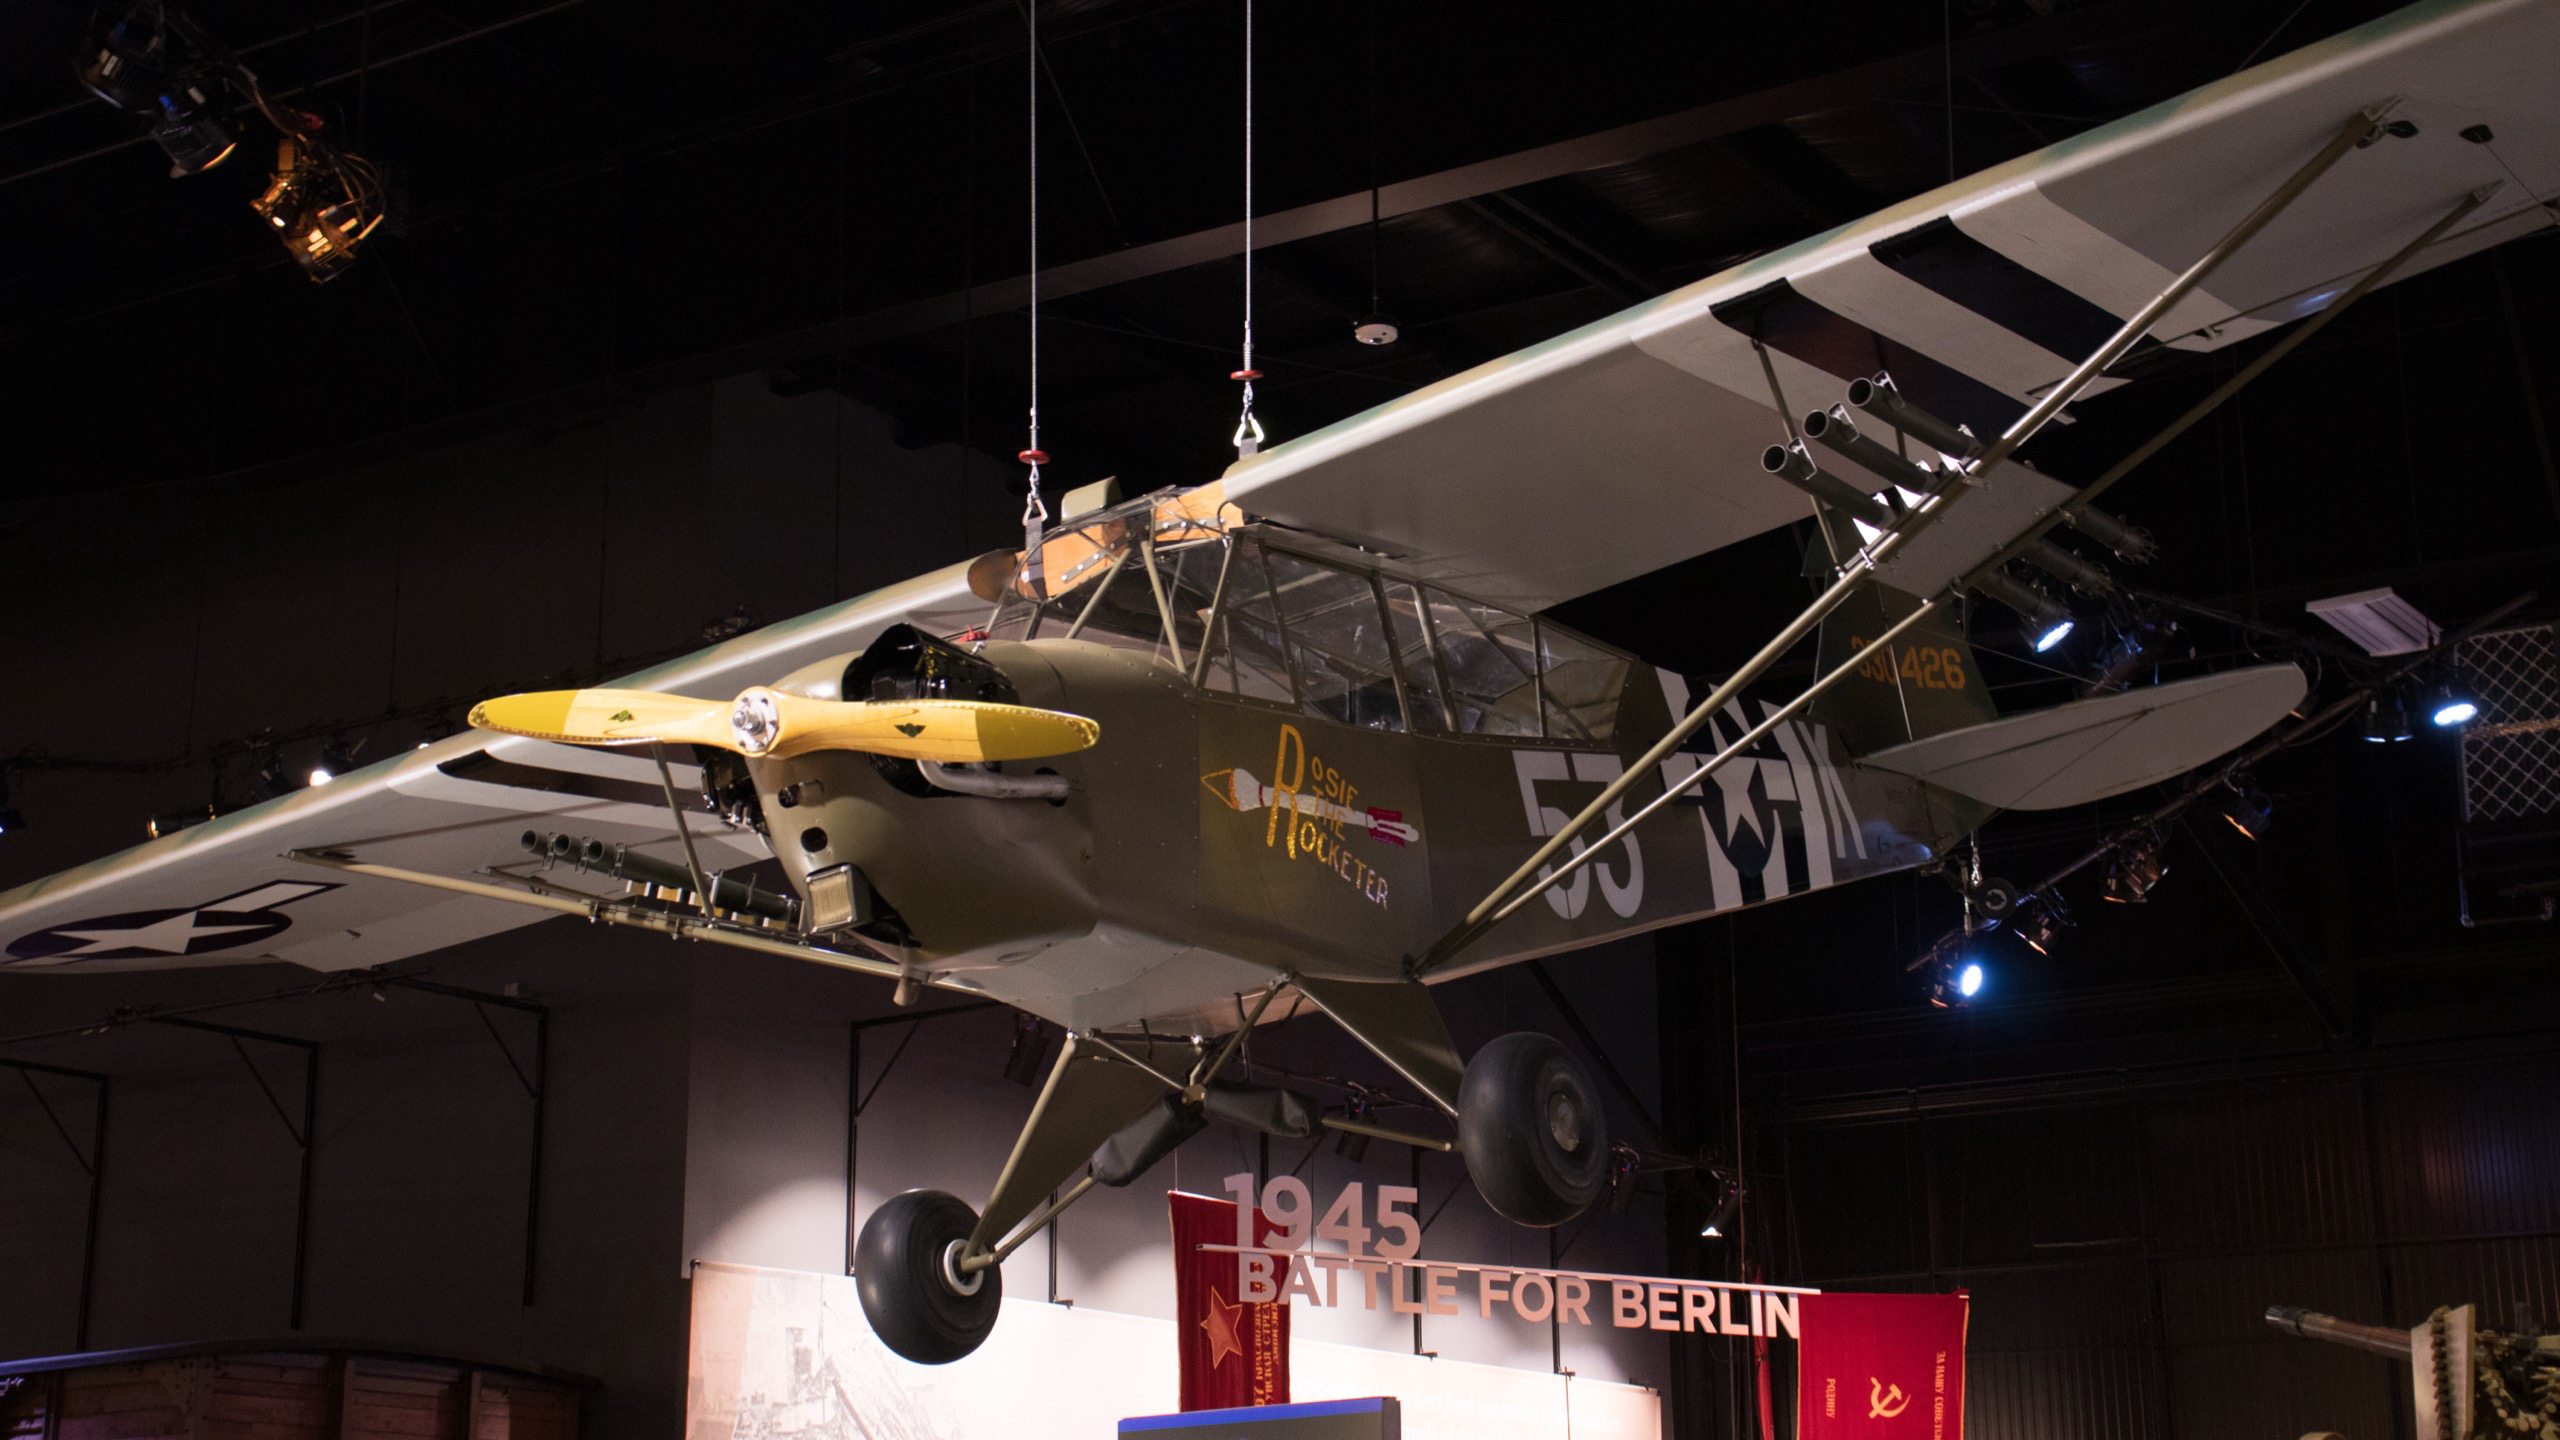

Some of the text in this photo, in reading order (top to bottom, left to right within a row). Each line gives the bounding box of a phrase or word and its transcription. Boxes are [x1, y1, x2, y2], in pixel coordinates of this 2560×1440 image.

[1312, 786, 1346, 841] THE
[1223, 1172, 1421, 1260] 1945
[1238, 1252, 1800, 1340] BATTLE FOR BERLIN
